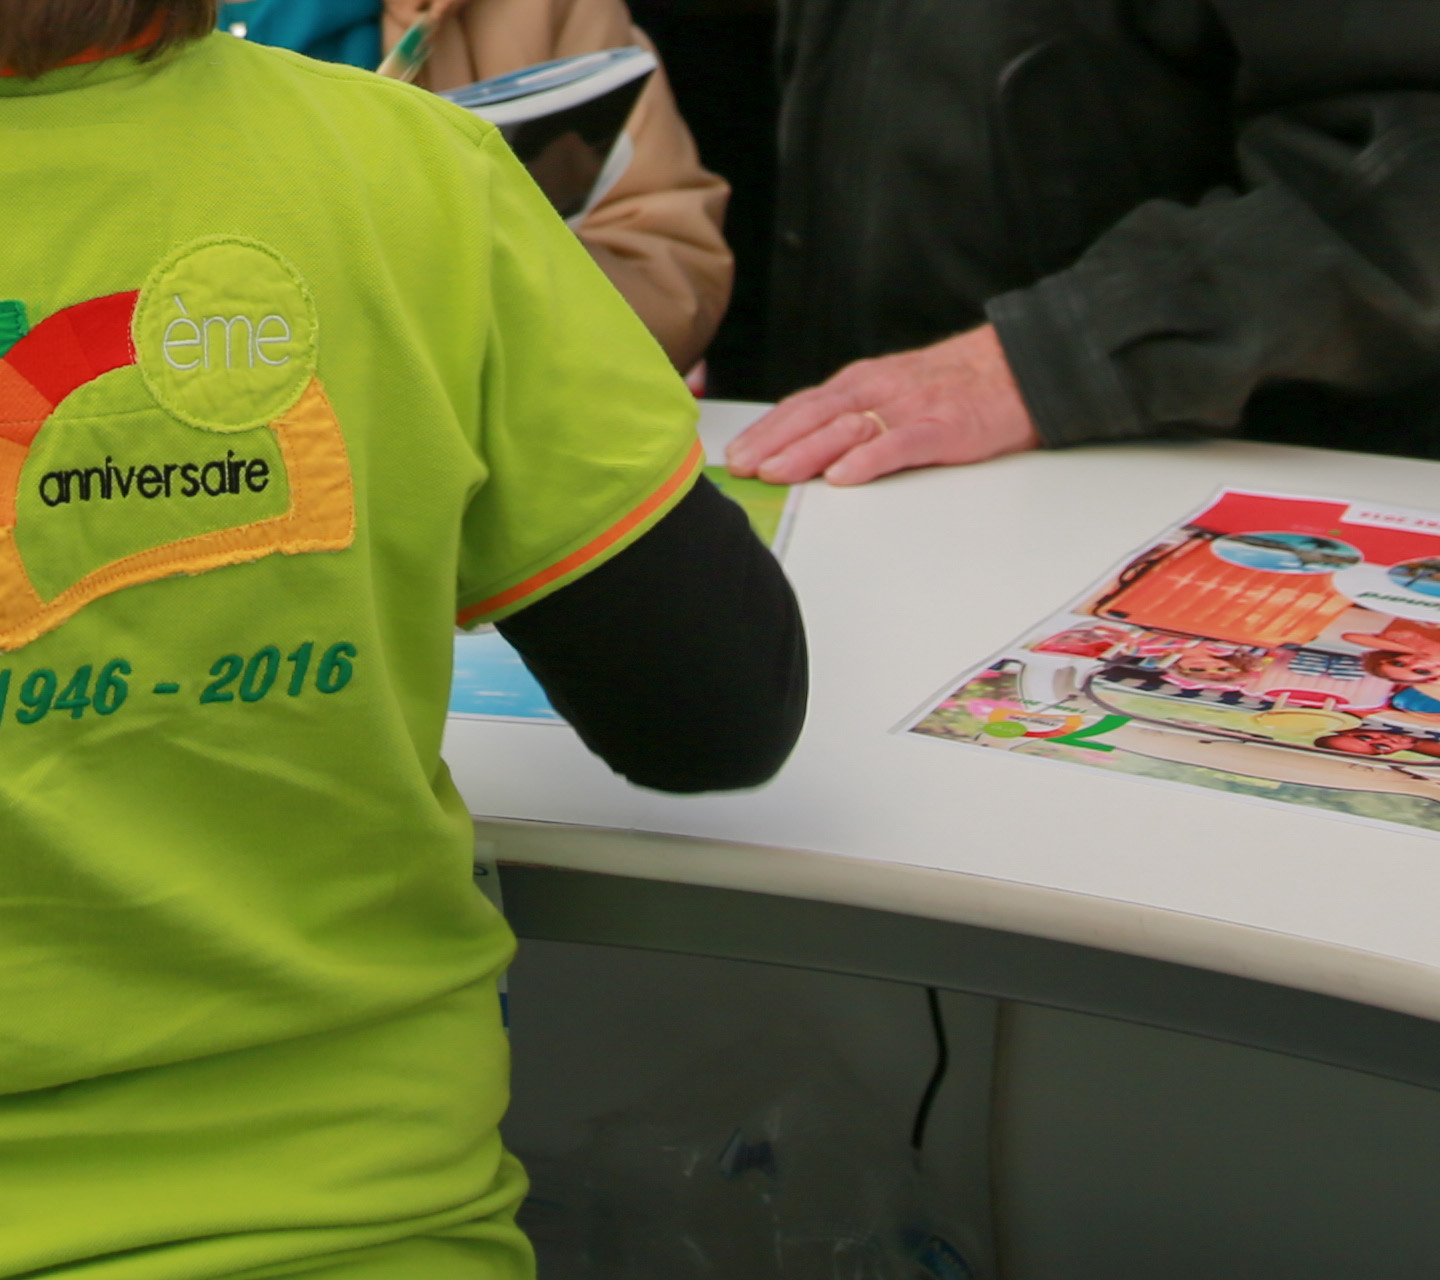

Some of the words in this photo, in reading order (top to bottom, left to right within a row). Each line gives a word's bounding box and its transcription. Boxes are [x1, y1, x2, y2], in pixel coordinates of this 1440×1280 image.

[161, 294, 292, 370] ème
[38, 448, 270, 508] anniversaire
[199, 640, 357, 706] 2016
